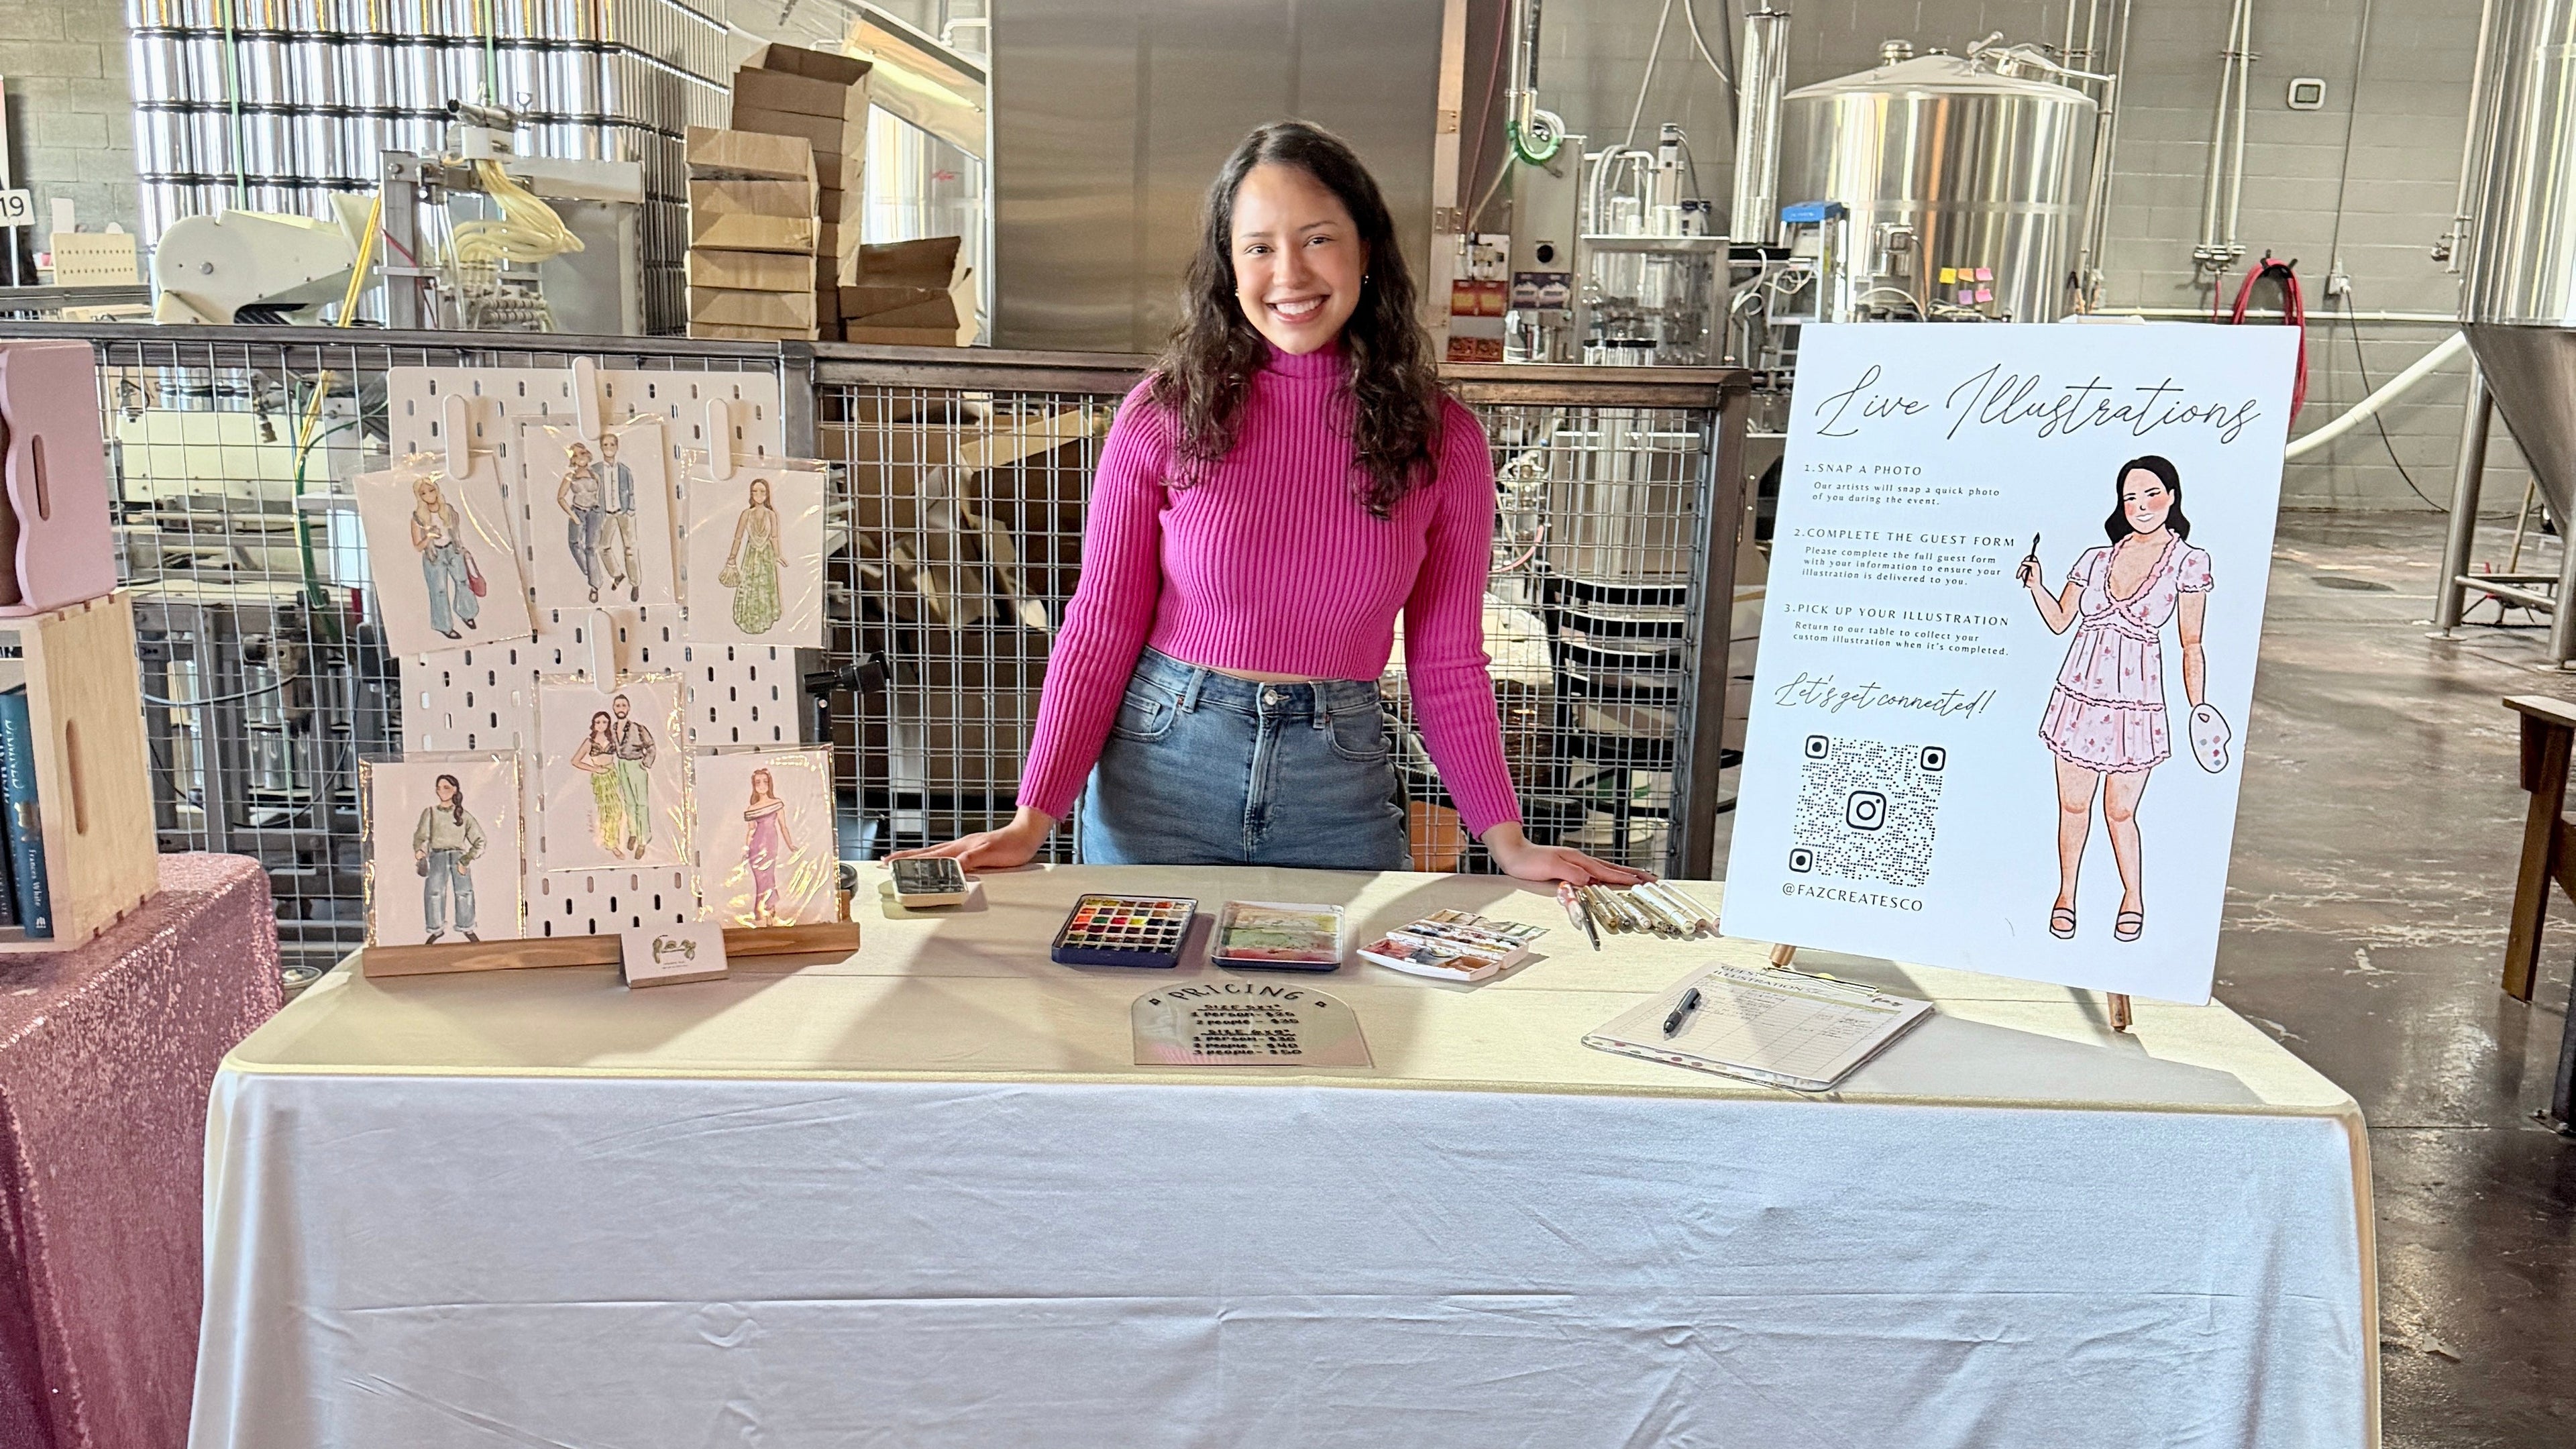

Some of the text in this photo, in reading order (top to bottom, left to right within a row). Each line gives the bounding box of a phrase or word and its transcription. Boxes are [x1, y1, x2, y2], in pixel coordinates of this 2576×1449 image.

[1815, 363, 2261, 445] Live Illustrations
[1859, 466, 1868, 474] A
[1874, 465, 1923, 476] PHOTO
[1812, 492, 1941, 506] of you during the event.
[1813, 482, 1833, 490] Our
[1836, 482, 1870, 491] artists
[1874, 483, 1893, 492] will
[1897, 485, 1921, 494] snap
[1935, 486, 1964, 496] quick
[1969, 487, 2000, 497] photo
[1886, 532, 1913, 543] THE
[1920, 534, 1967, 545] GUEST
[1974, 537, 2015, 547] FORM
[1805, 546, 1996, 564] Please complete the full guest form
[1804, 557, 2001, 576] with your information to ensure your
[1802, 568, 1860, 579] illustration
[1864, 572, 1872, 580] is
[1876, 572, 1925, 583] delivered
[1945, 578, 1968, 586] you.
[1835, 606, 1853, 616] UP
[1859, 608, 1896, 620] YOUR
[1903, 610, 2010, 627] ILLUSTRATION
[1795, 621, 1980, 643] Return to our table to collect your
[1793, 633, 2010, 656] custom illustration when it's completed.
[1774, 672, 1997, 719] Let's get connected!
[1782, 883, 1923, 912] @FAZCREATESCO
[1168, 983, 1305, 1002] PRICING
